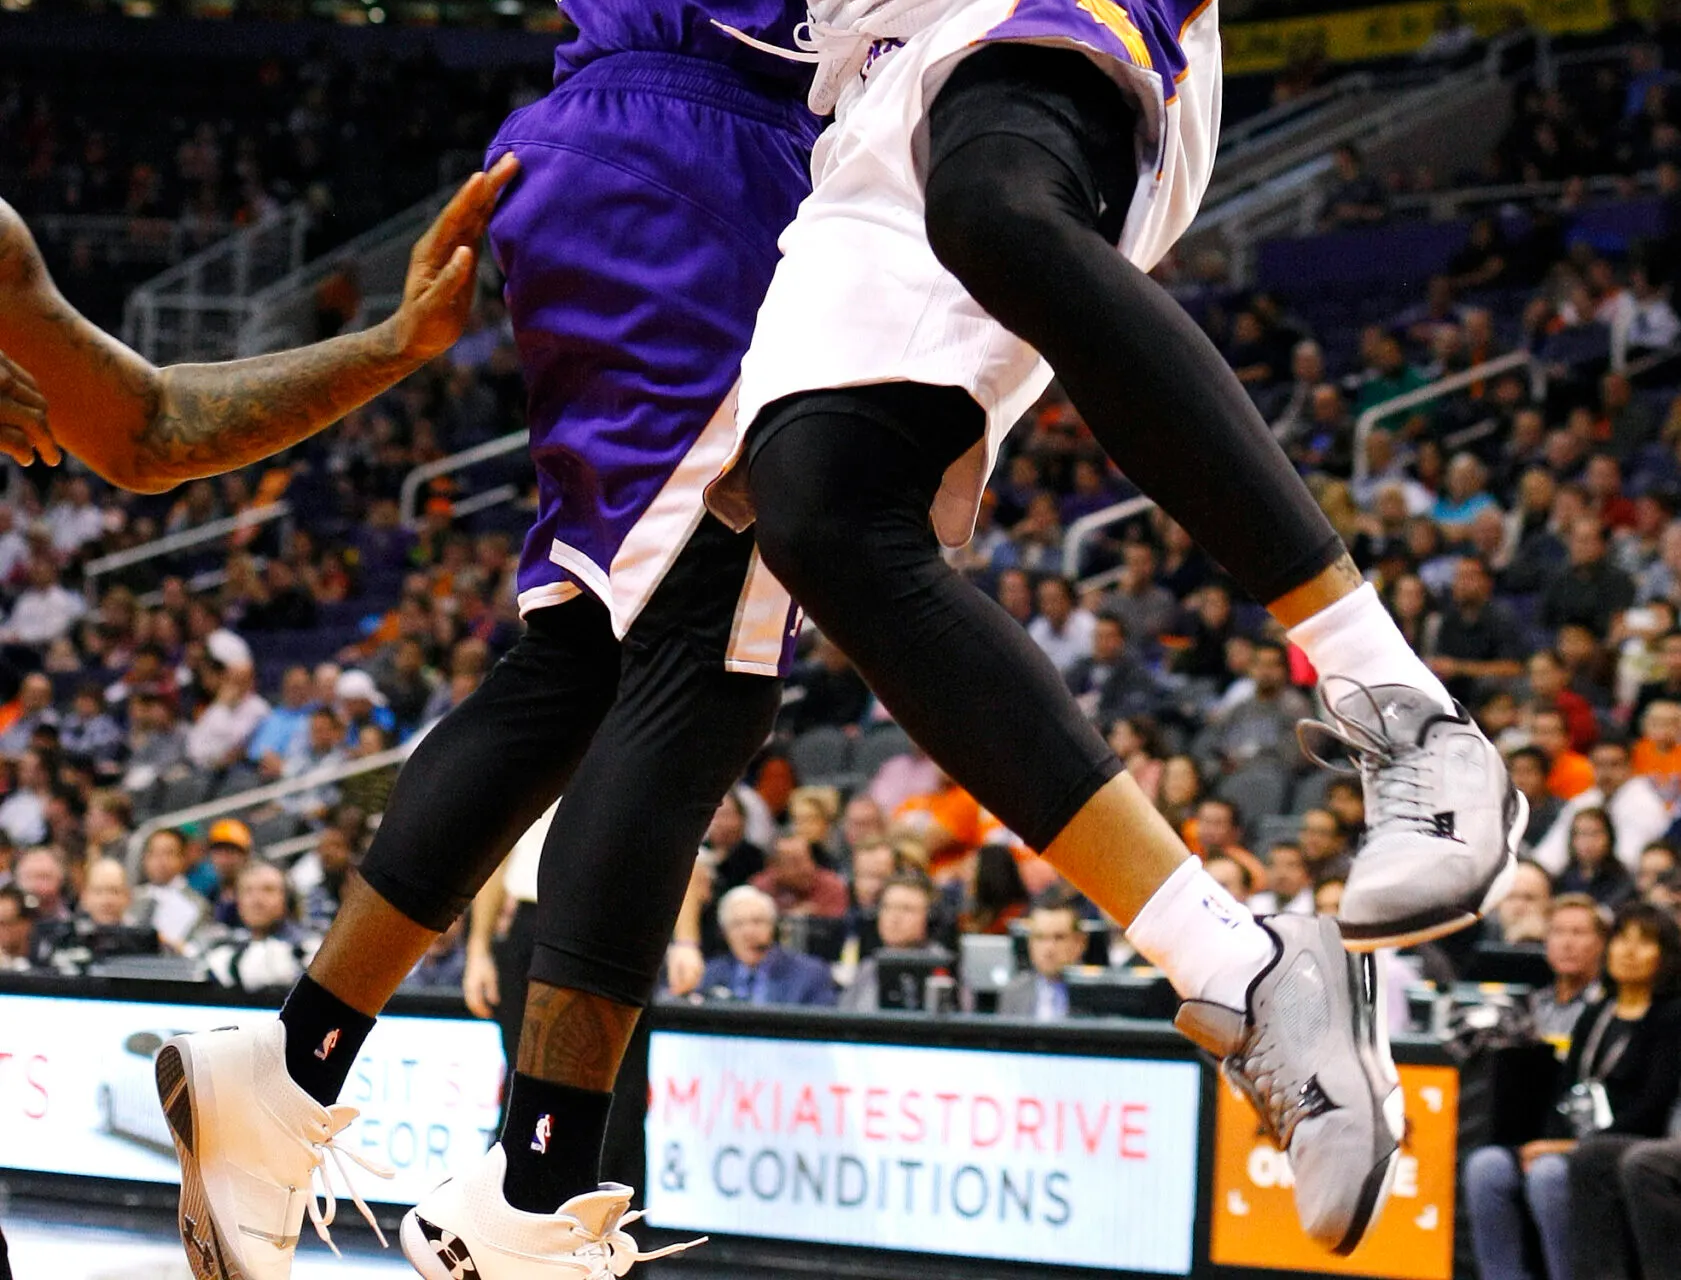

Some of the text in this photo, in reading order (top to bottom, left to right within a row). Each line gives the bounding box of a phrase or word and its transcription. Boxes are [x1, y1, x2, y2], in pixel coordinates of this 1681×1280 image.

[360, 1119, 450, 1170] FOR
[647, 1072, 1150, 1161] M/KIATESTDRIVE
[659, 1141, 1074, 1226] & CONDITIONS
